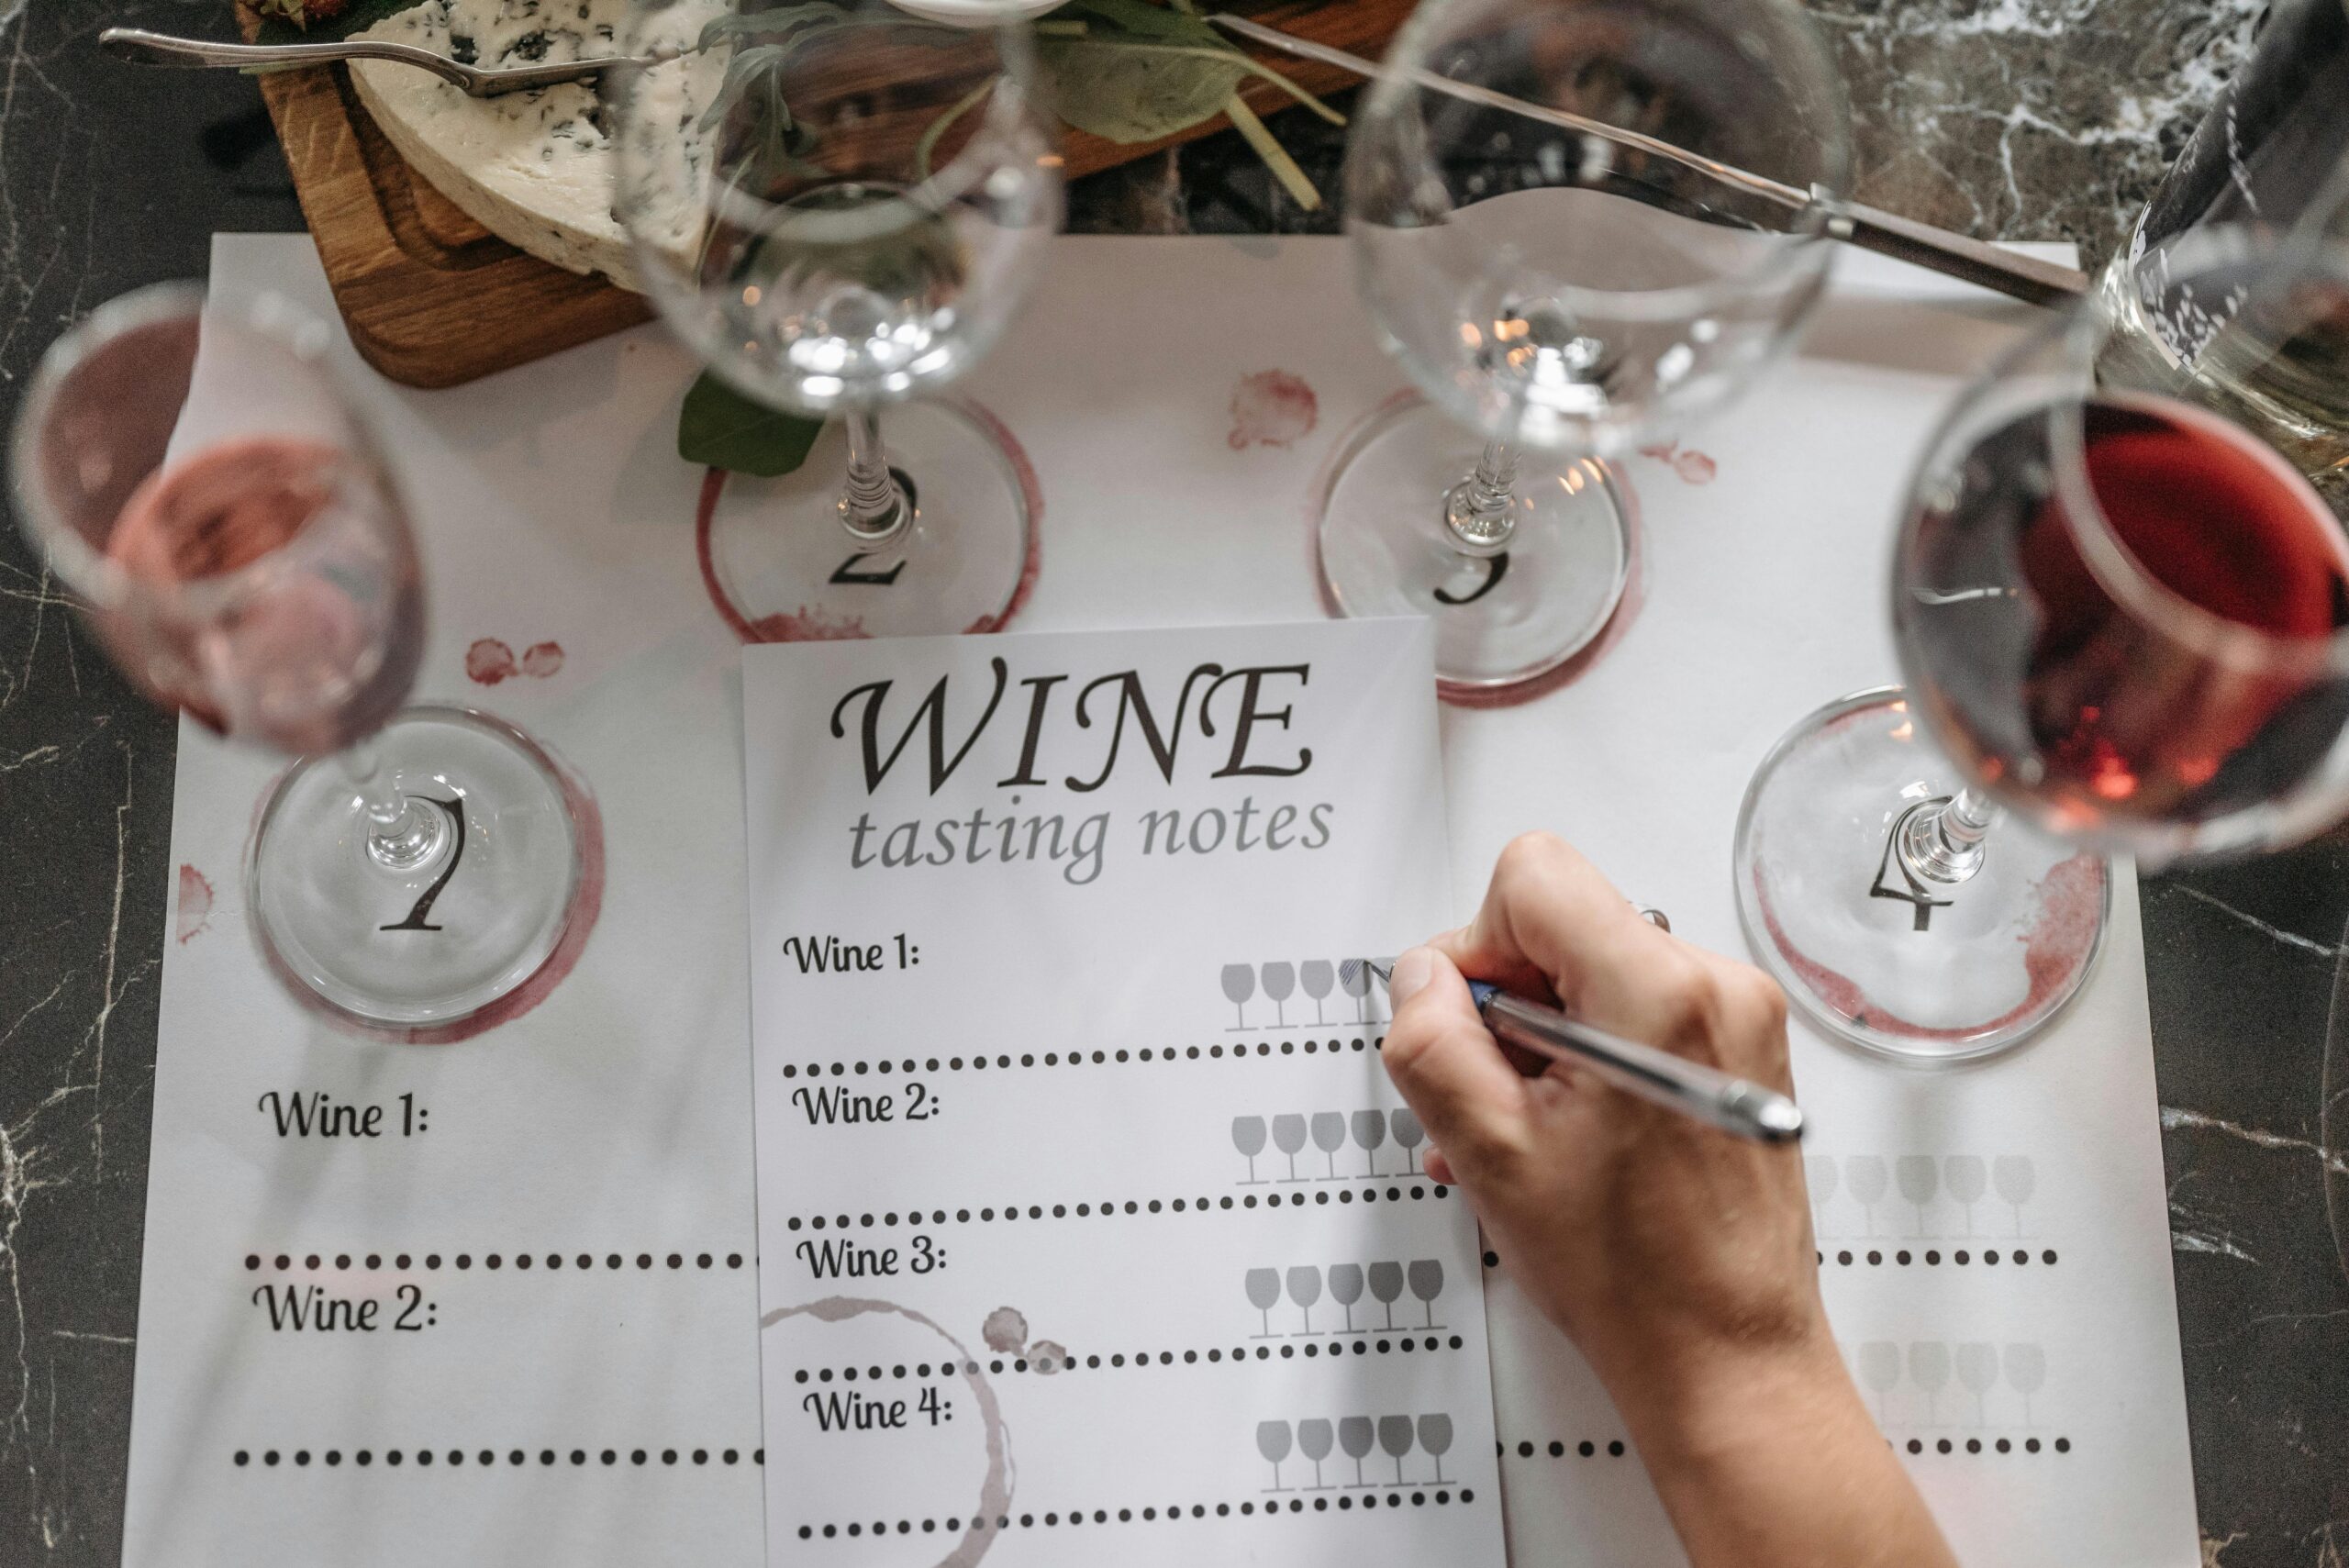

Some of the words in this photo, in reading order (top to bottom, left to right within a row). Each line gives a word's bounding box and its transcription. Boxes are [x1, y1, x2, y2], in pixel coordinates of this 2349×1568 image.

[829, 656, 1312, 796] WINE
[379, 795, 466, 931] 1
[848, 795, 1111, 885] tasting
[1139, 796, 1333, 855] notes
[1869, 795, 1954, 930] 4
[783, 935, 884, 974] Wine
[893, 933, 919, 970] 1:
[258, 1091, 384, 1139] Wine
[398, 1091, 429, 1138] 1:
[792, 1085, 894, 1125] Wine
[905, 1082, 940, 1120] 2:
[796, 1239, 899, 1279] Wine
[910, 1235, 947, 1274] 3:
[251, 1284, 379, 1332] Wine
[394, 1284, 437, 1332] 2:
[802, 1390, 907, 1432] Wine
[918, 1386, 952, 1427] 4:
